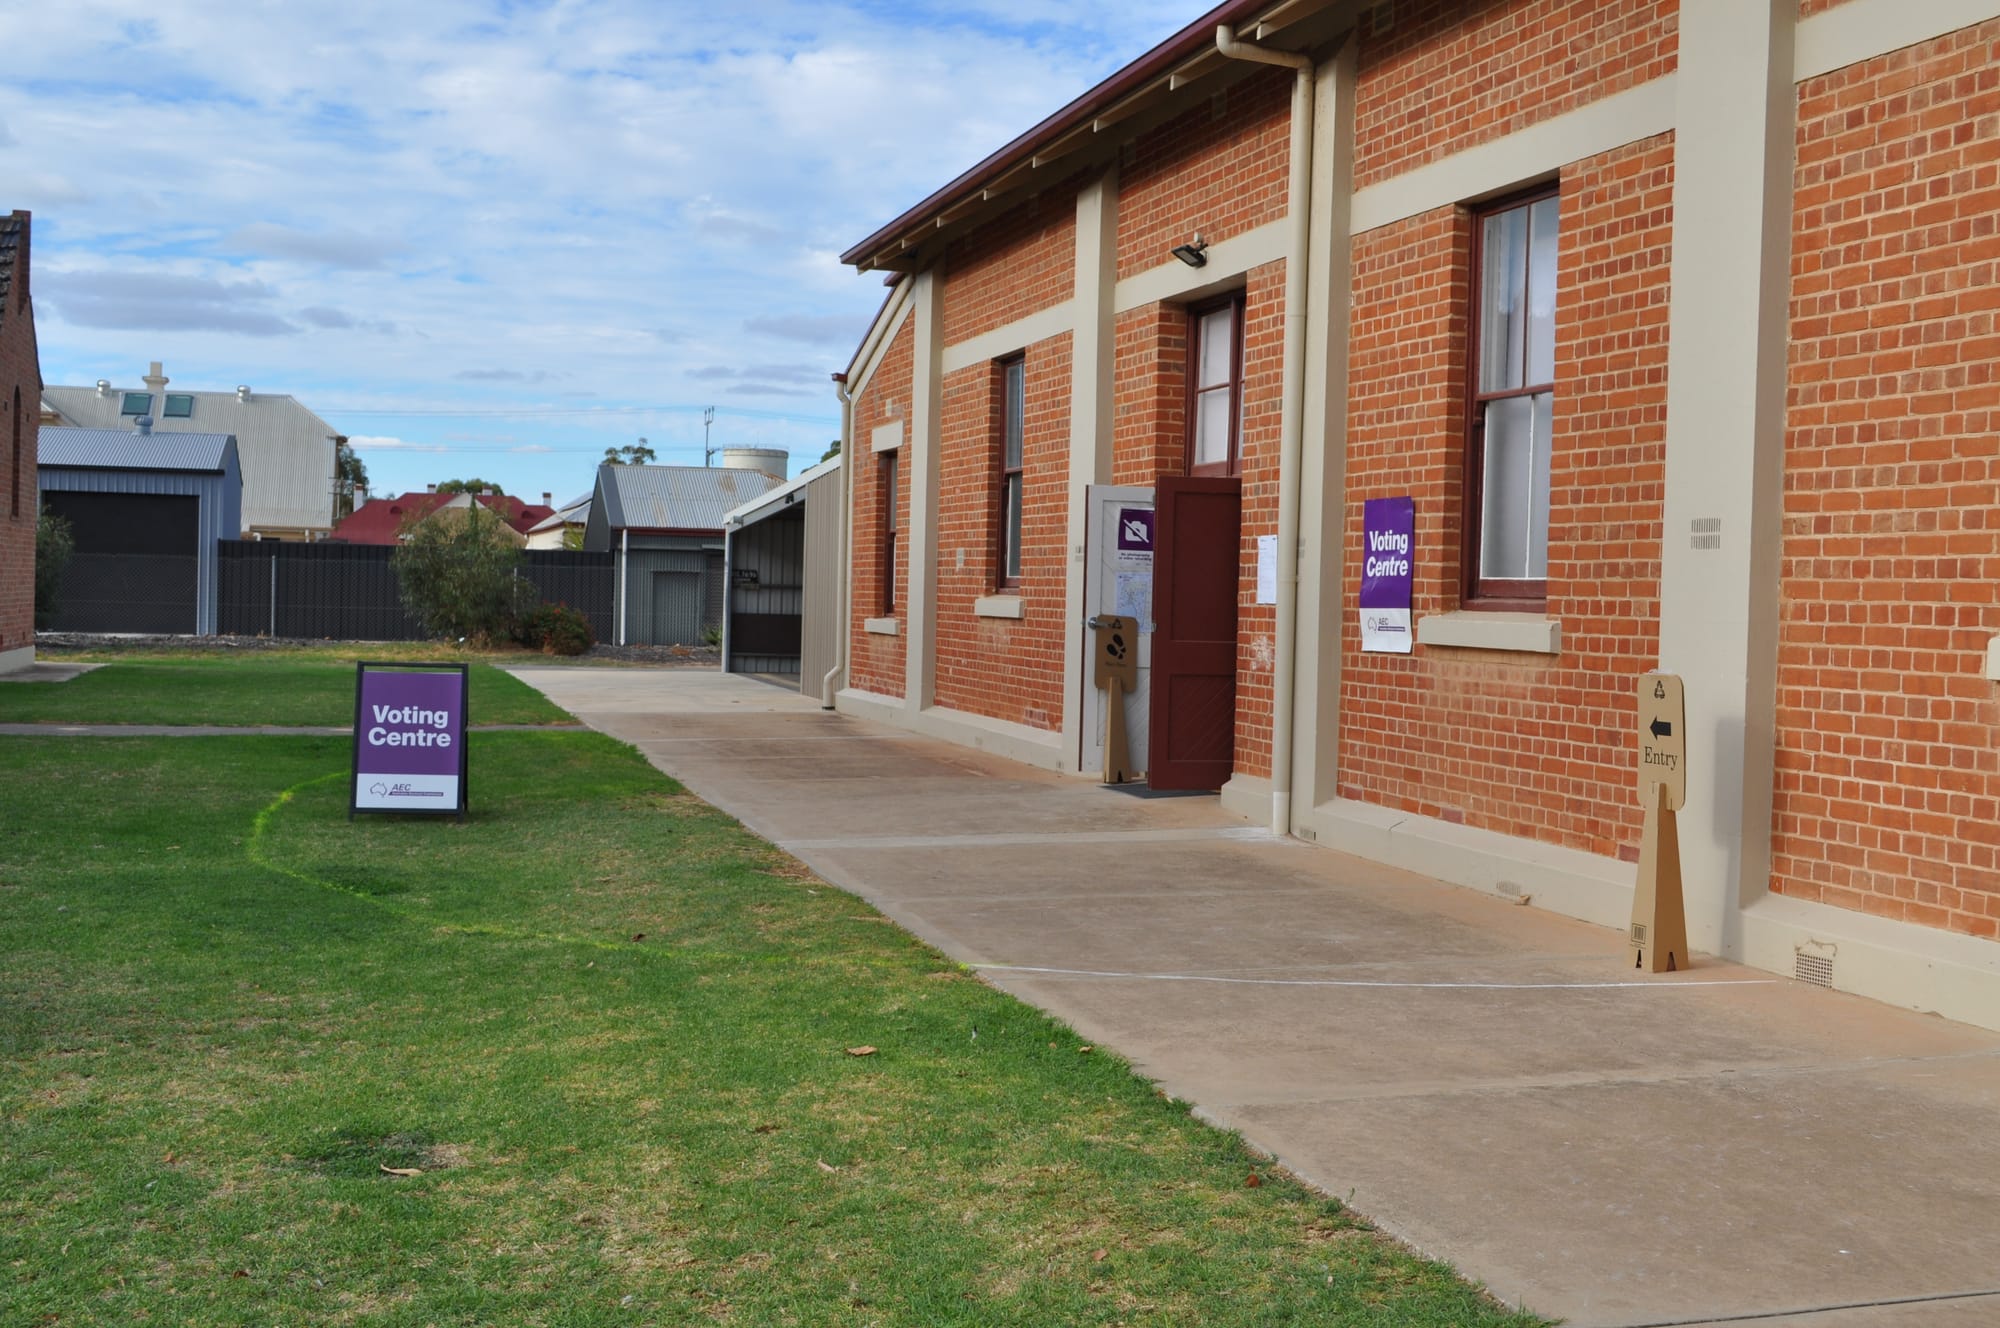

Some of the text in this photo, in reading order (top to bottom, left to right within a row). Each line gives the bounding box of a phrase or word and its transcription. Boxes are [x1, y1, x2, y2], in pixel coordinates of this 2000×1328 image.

[1369, 529, 1409, 555] Voting
[1366, 555, 1409, 577] Centre
[372, 704, 449, 729] Voting
[368, 726, 452, 747] Centre
[1644, 745, 1678, 771] Entry
[391, 783, 412, 791] AEC
